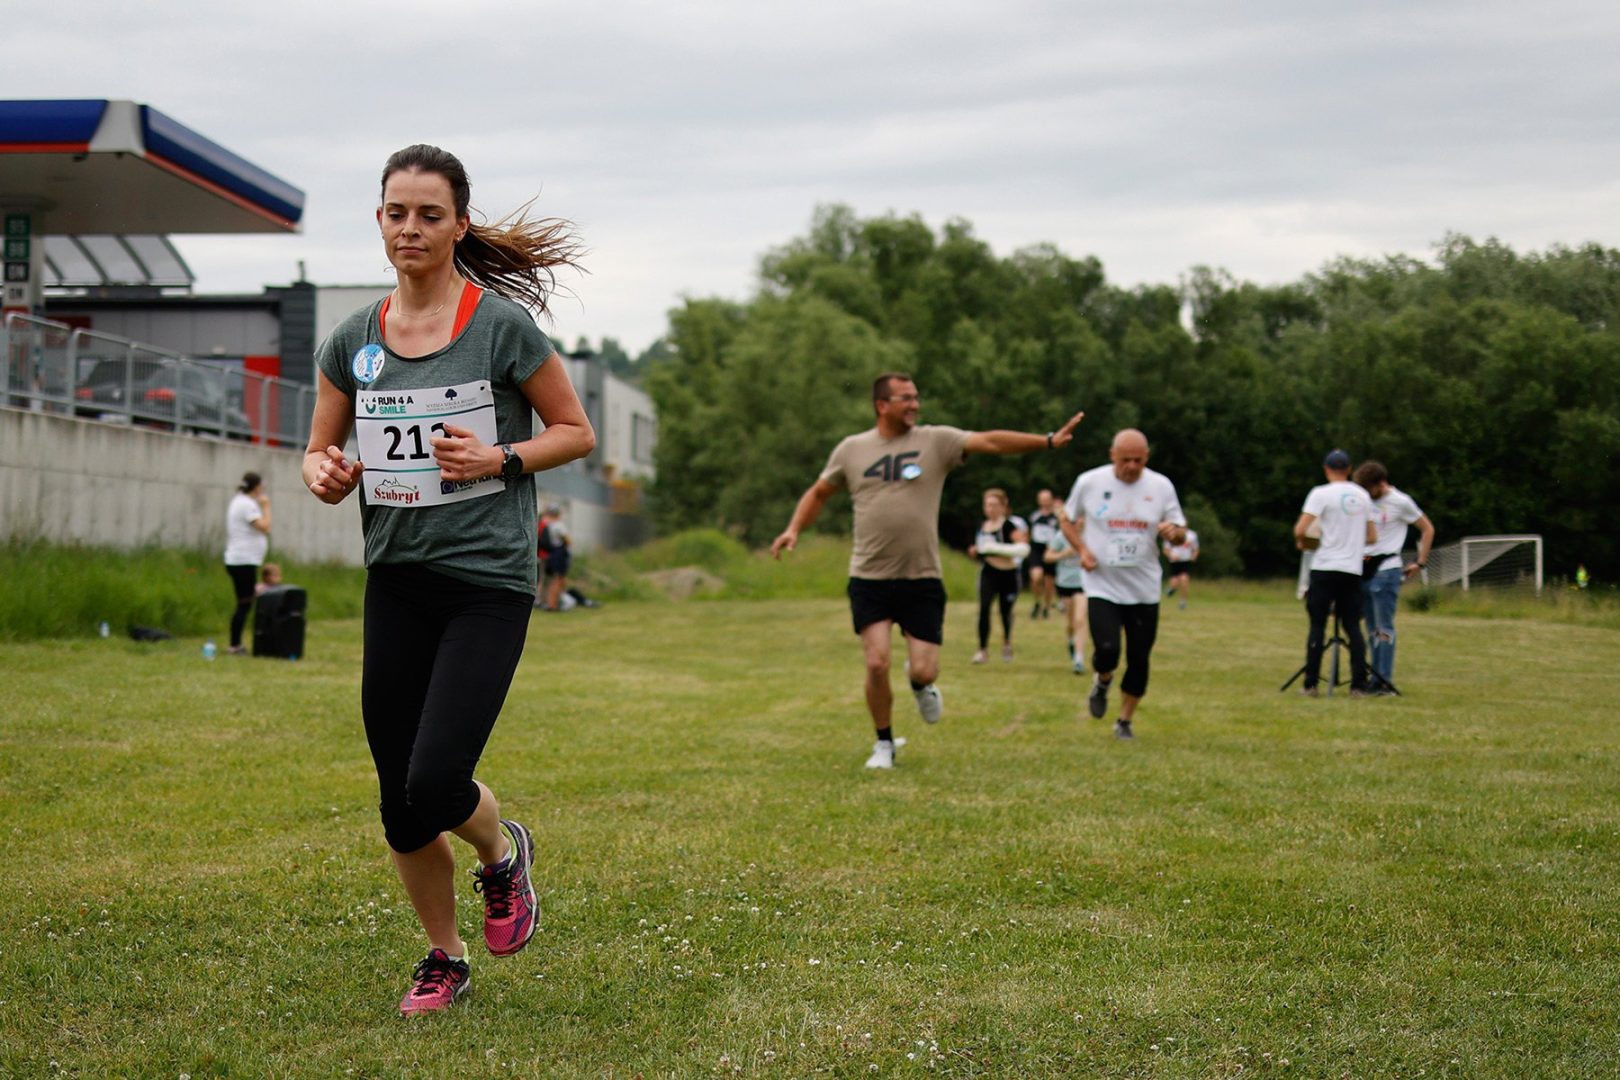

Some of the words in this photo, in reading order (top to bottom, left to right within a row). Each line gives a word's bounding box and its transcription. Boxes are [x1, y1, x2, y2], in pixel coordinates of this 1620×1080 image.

[378, 395, 397, 405] RUN
[398, 395, 405, 404] 4
[406, 395, 414, 404] A
[379, 405, 406, 414] SMILE
[374, 487, 420, 504] Szubryt
